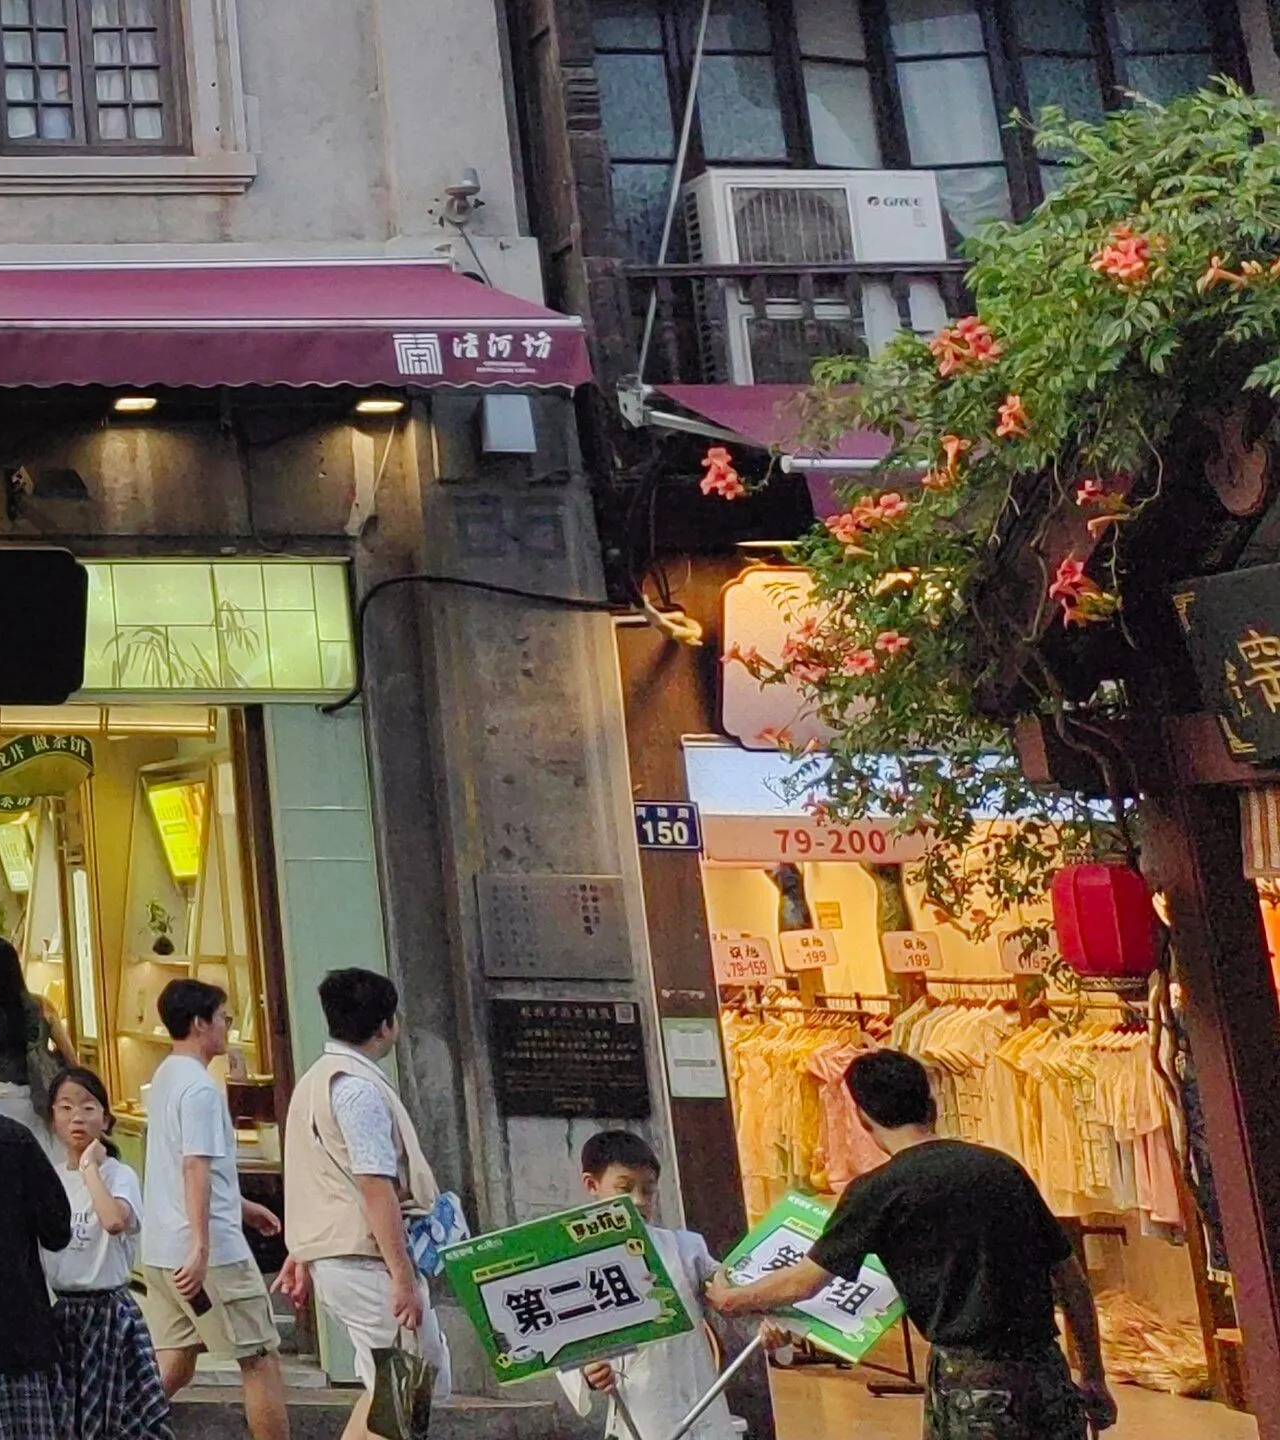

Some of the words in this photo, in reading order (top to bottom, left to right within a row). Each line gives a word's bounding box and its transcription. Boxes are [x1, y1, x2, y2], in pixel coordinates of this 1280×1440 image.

[453, 331, 552, 358] 清河坊
[642, 820, 689, 845] 150
[773, 829, 887, 855] 79-200
[760, 1244, 875, 1317] 第组
[504, 1263, 642, 1336] 第二组
